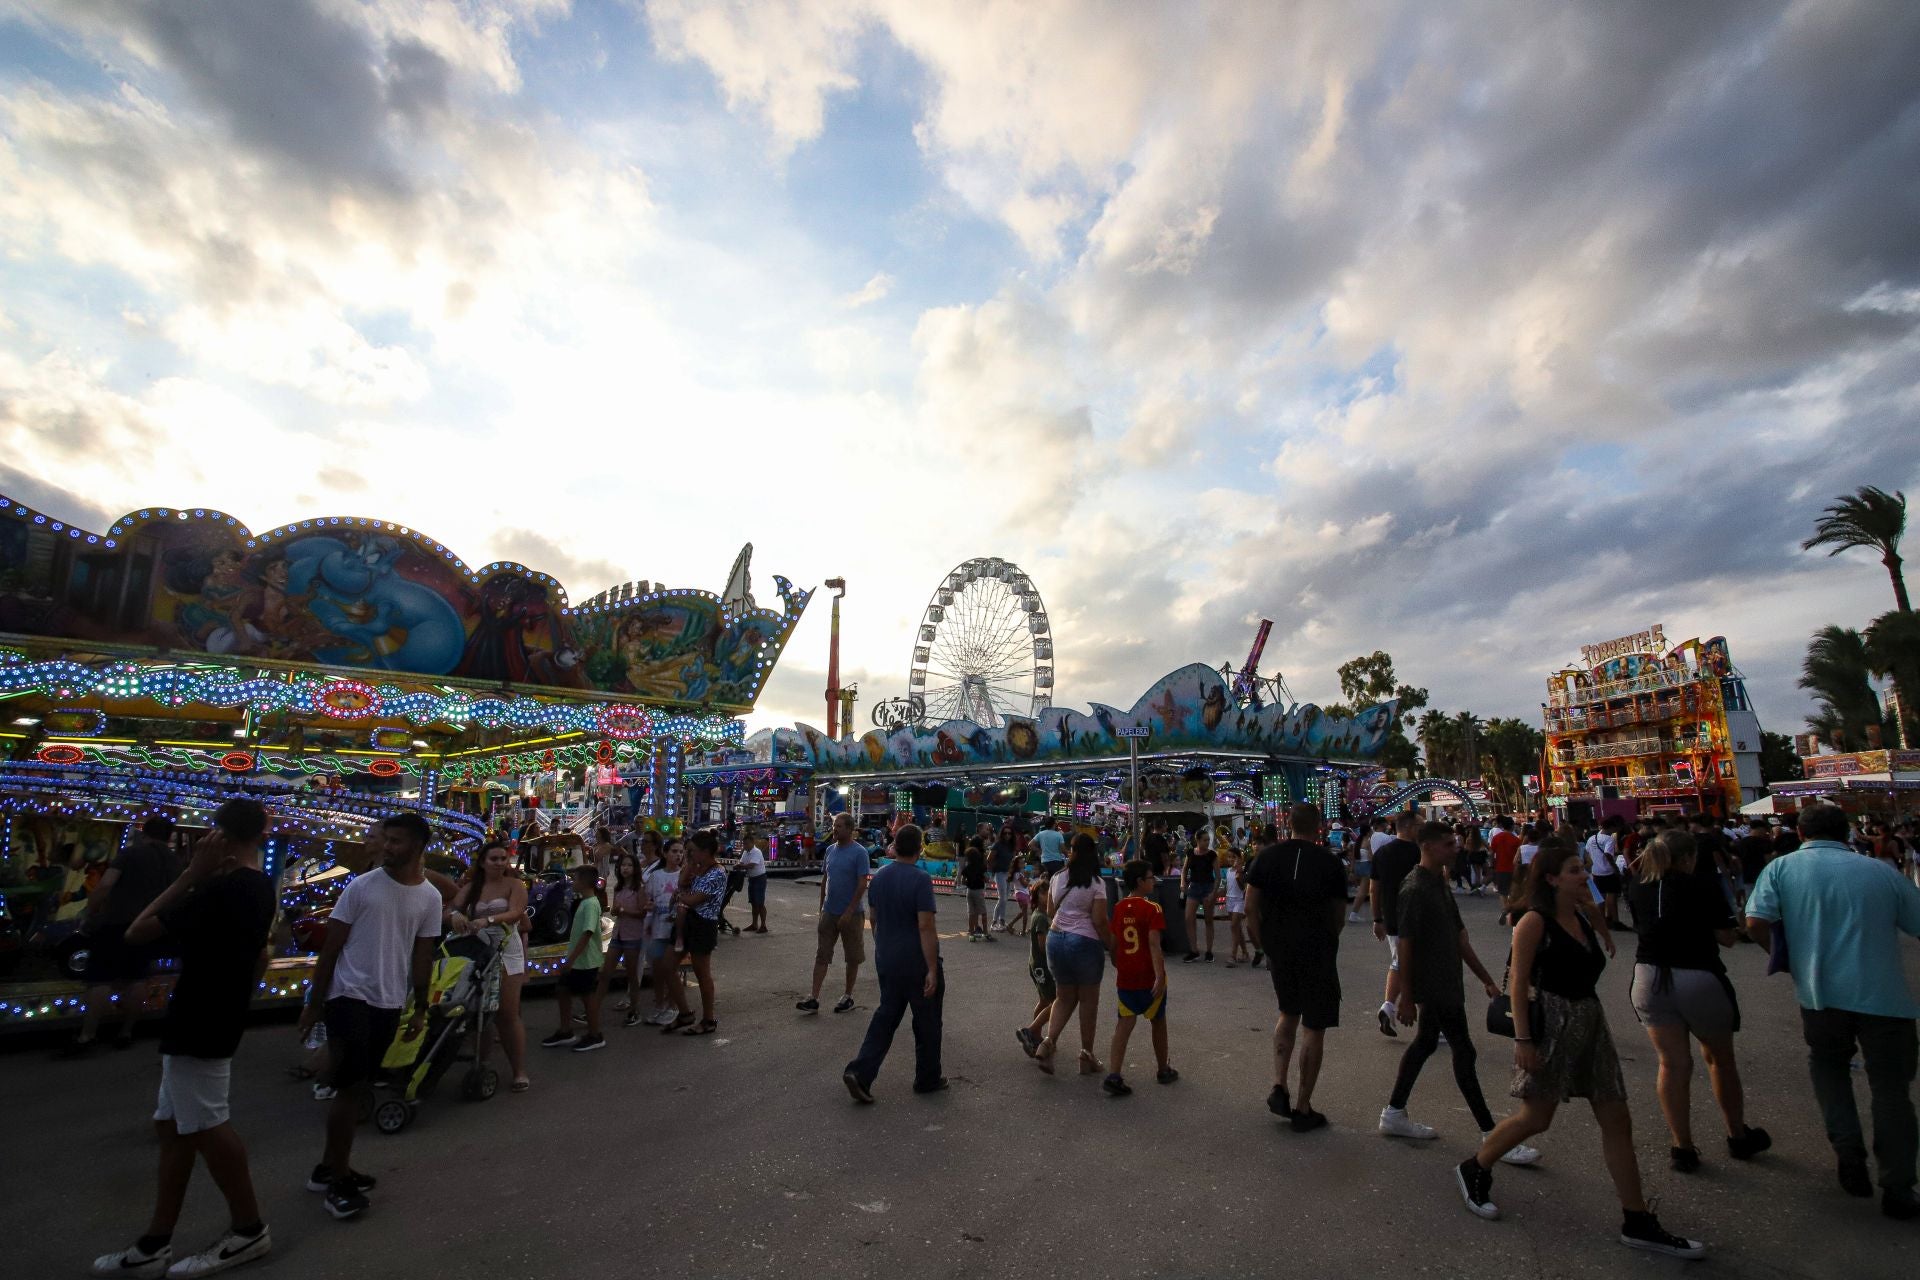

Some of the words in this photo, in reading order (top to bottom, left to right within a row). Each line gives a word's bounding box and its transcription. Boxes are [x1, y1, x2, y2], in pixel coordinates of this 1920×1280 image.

[1581, 631, 1652, 668] TORRENTE
[1651, 624, 1666, 655] 5
[1117, 728, 1148, 736] PAPELERA
[1123, 926, 1139, 954] 9
